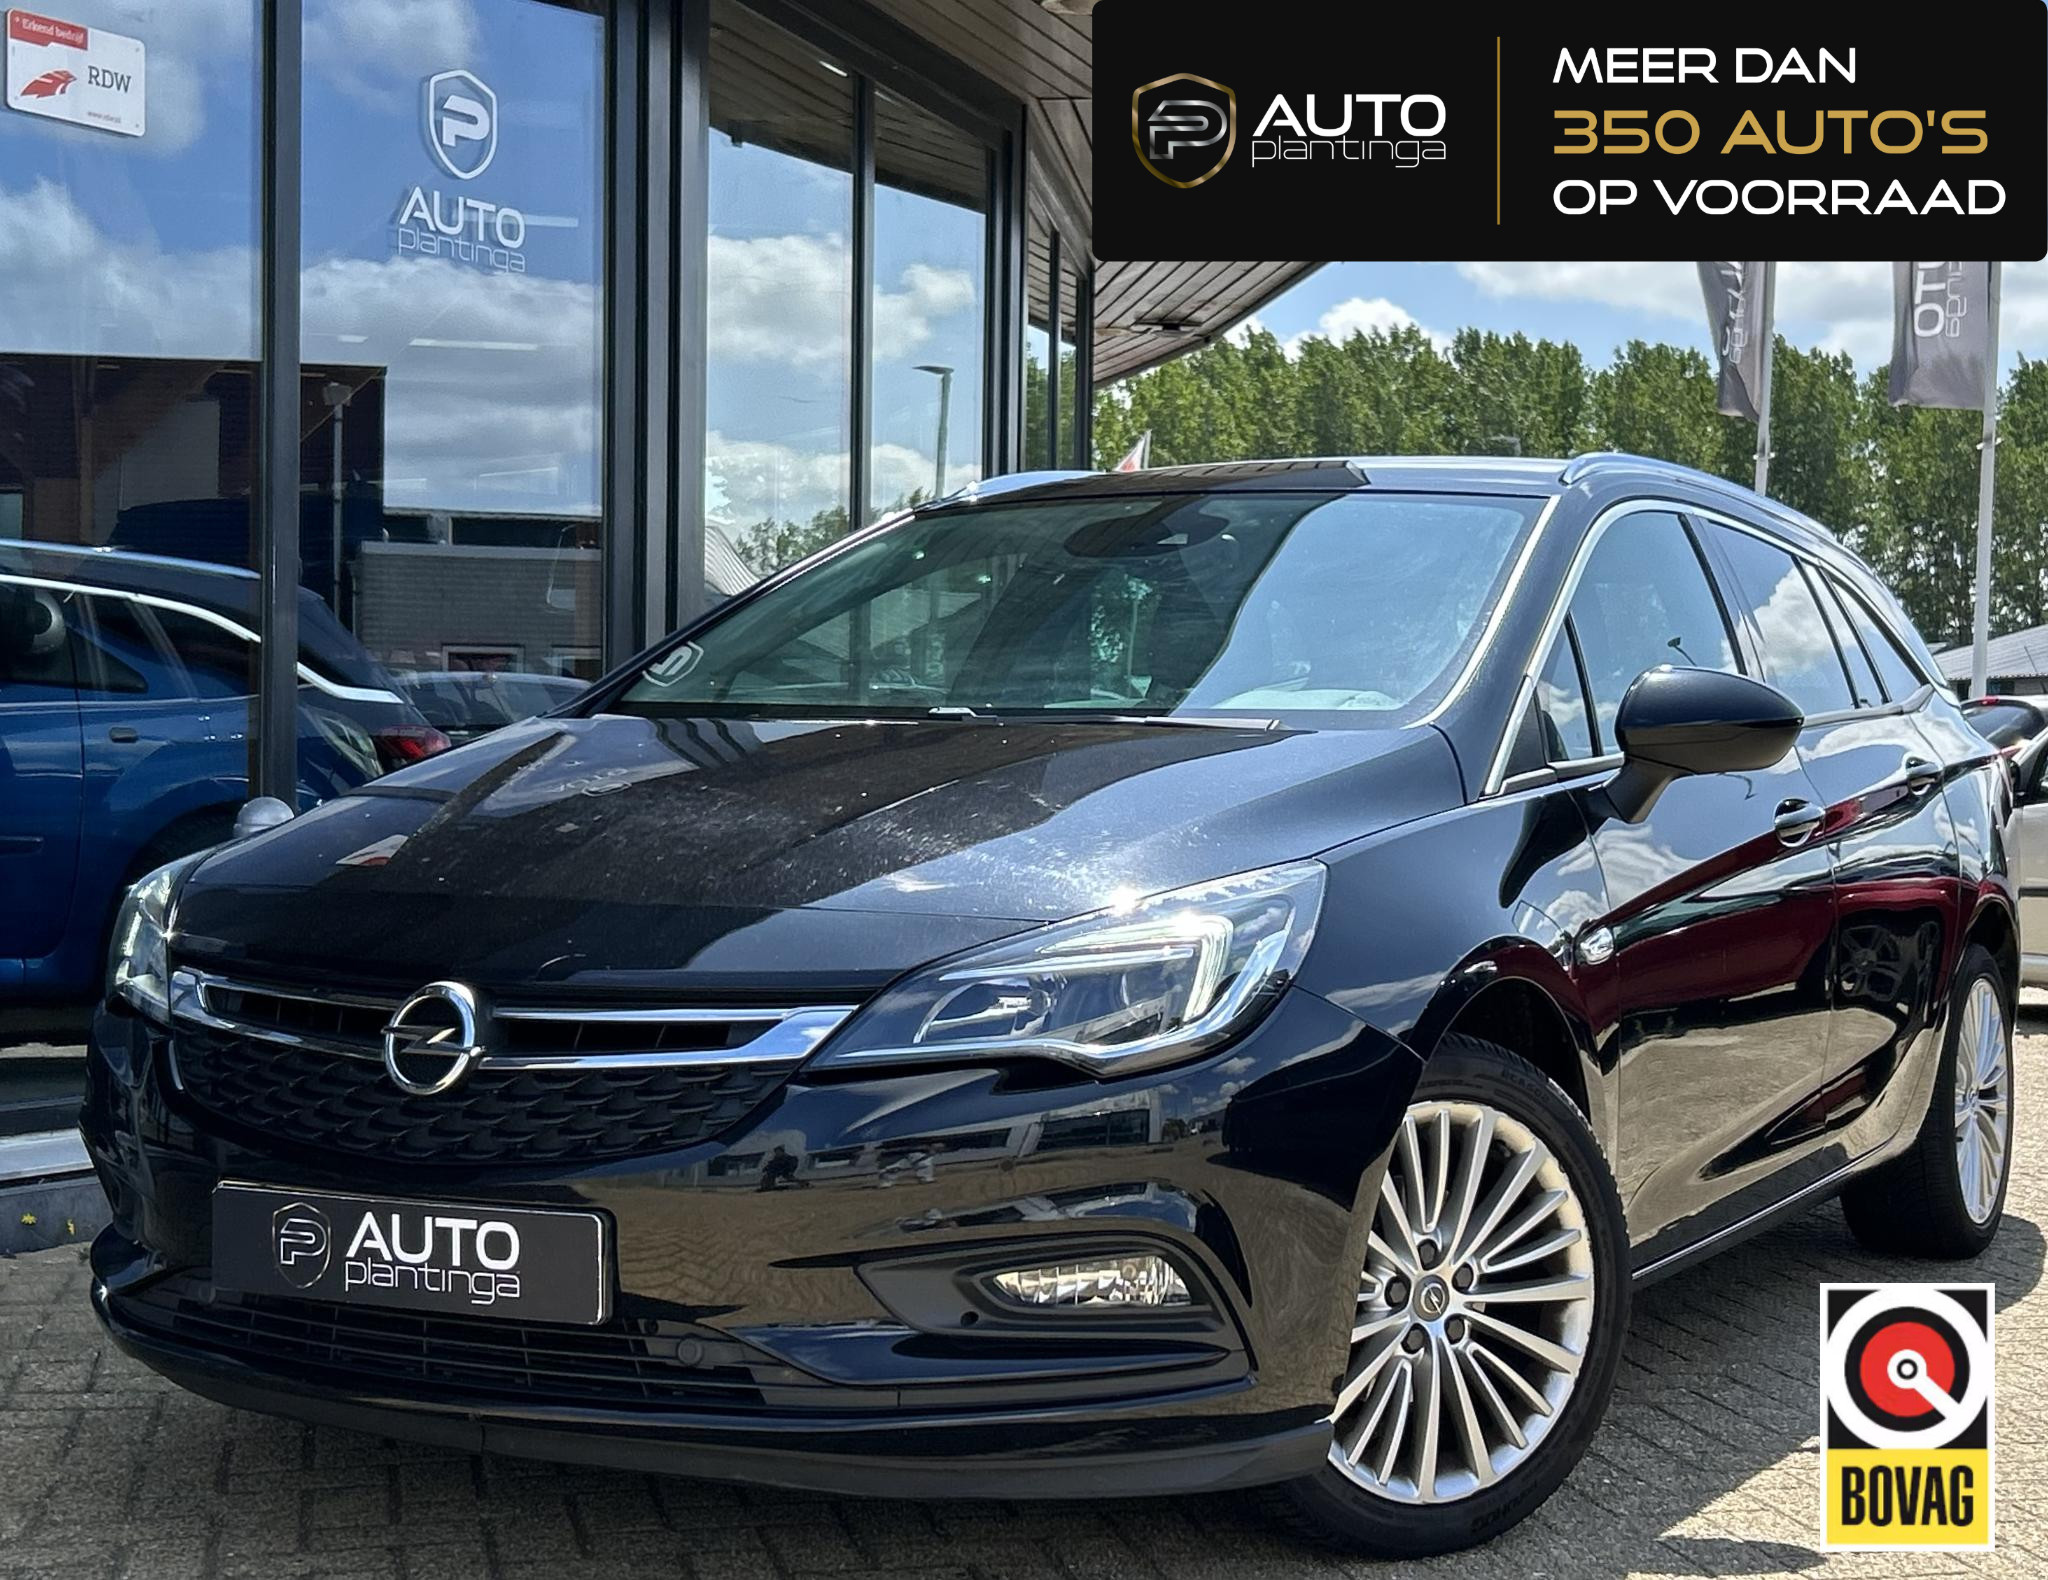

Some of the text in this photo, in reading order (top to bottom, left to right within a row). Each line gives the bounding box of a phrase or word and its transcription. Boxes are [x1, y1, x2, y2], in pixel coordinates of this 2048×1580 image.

[87, 65, 132, 94] RDW
[400, 186, 526, 249] AUTO
[398, 227, 526, 273] plantinga
[345, 1211, 520, 1271] AUTO
[344, 1259, 520, 1305] plantinga
